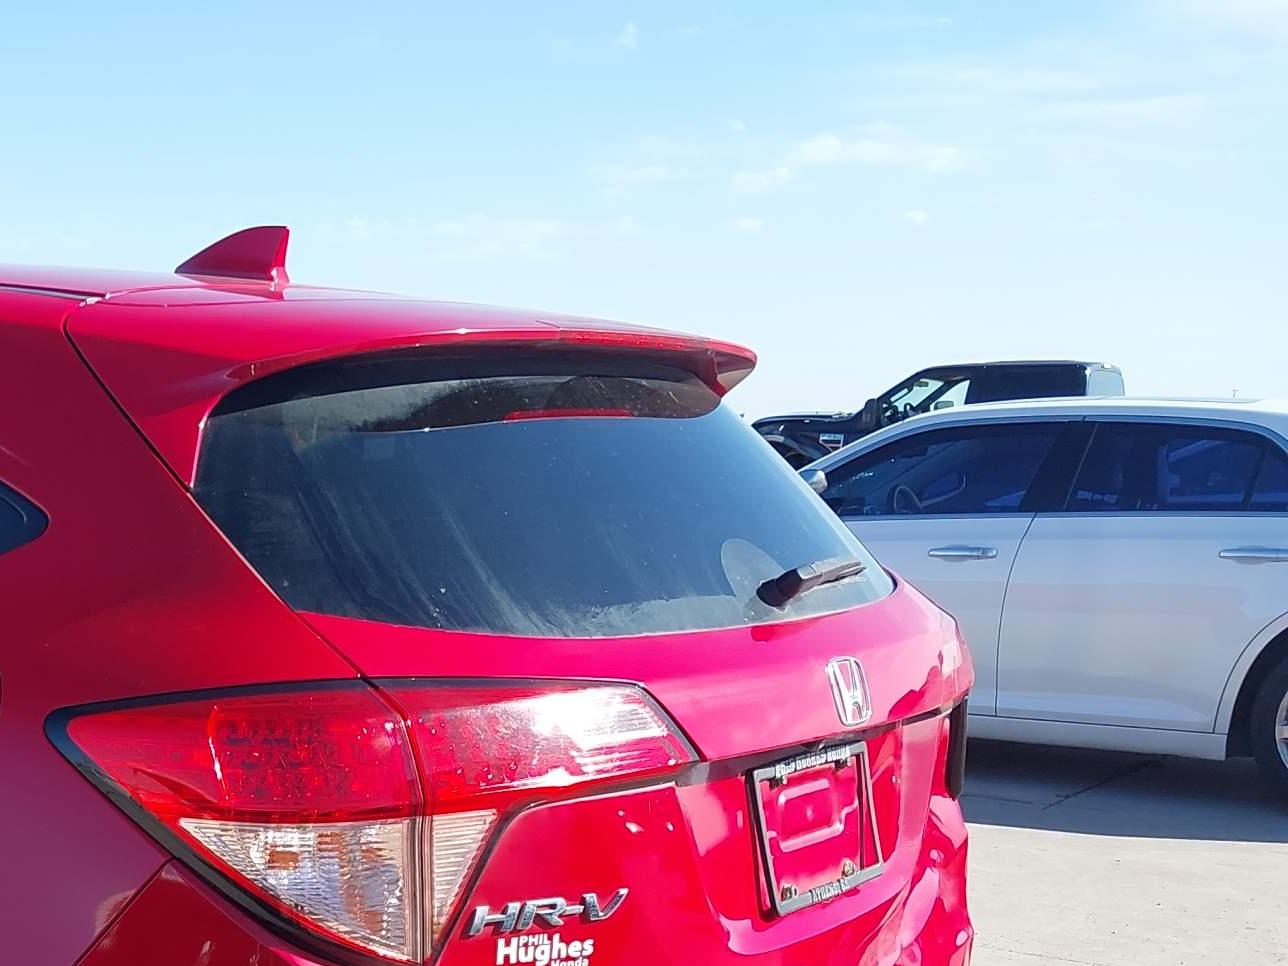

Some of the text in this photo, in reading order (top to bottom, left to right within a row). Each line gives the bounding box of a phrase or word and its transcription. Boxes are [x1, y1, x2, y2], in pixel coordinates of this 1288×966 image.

[463, 887, 630, 936] HR-V
[496, 932, 594, 966] Hughes
[518, 933, 551, 947] PHIL
